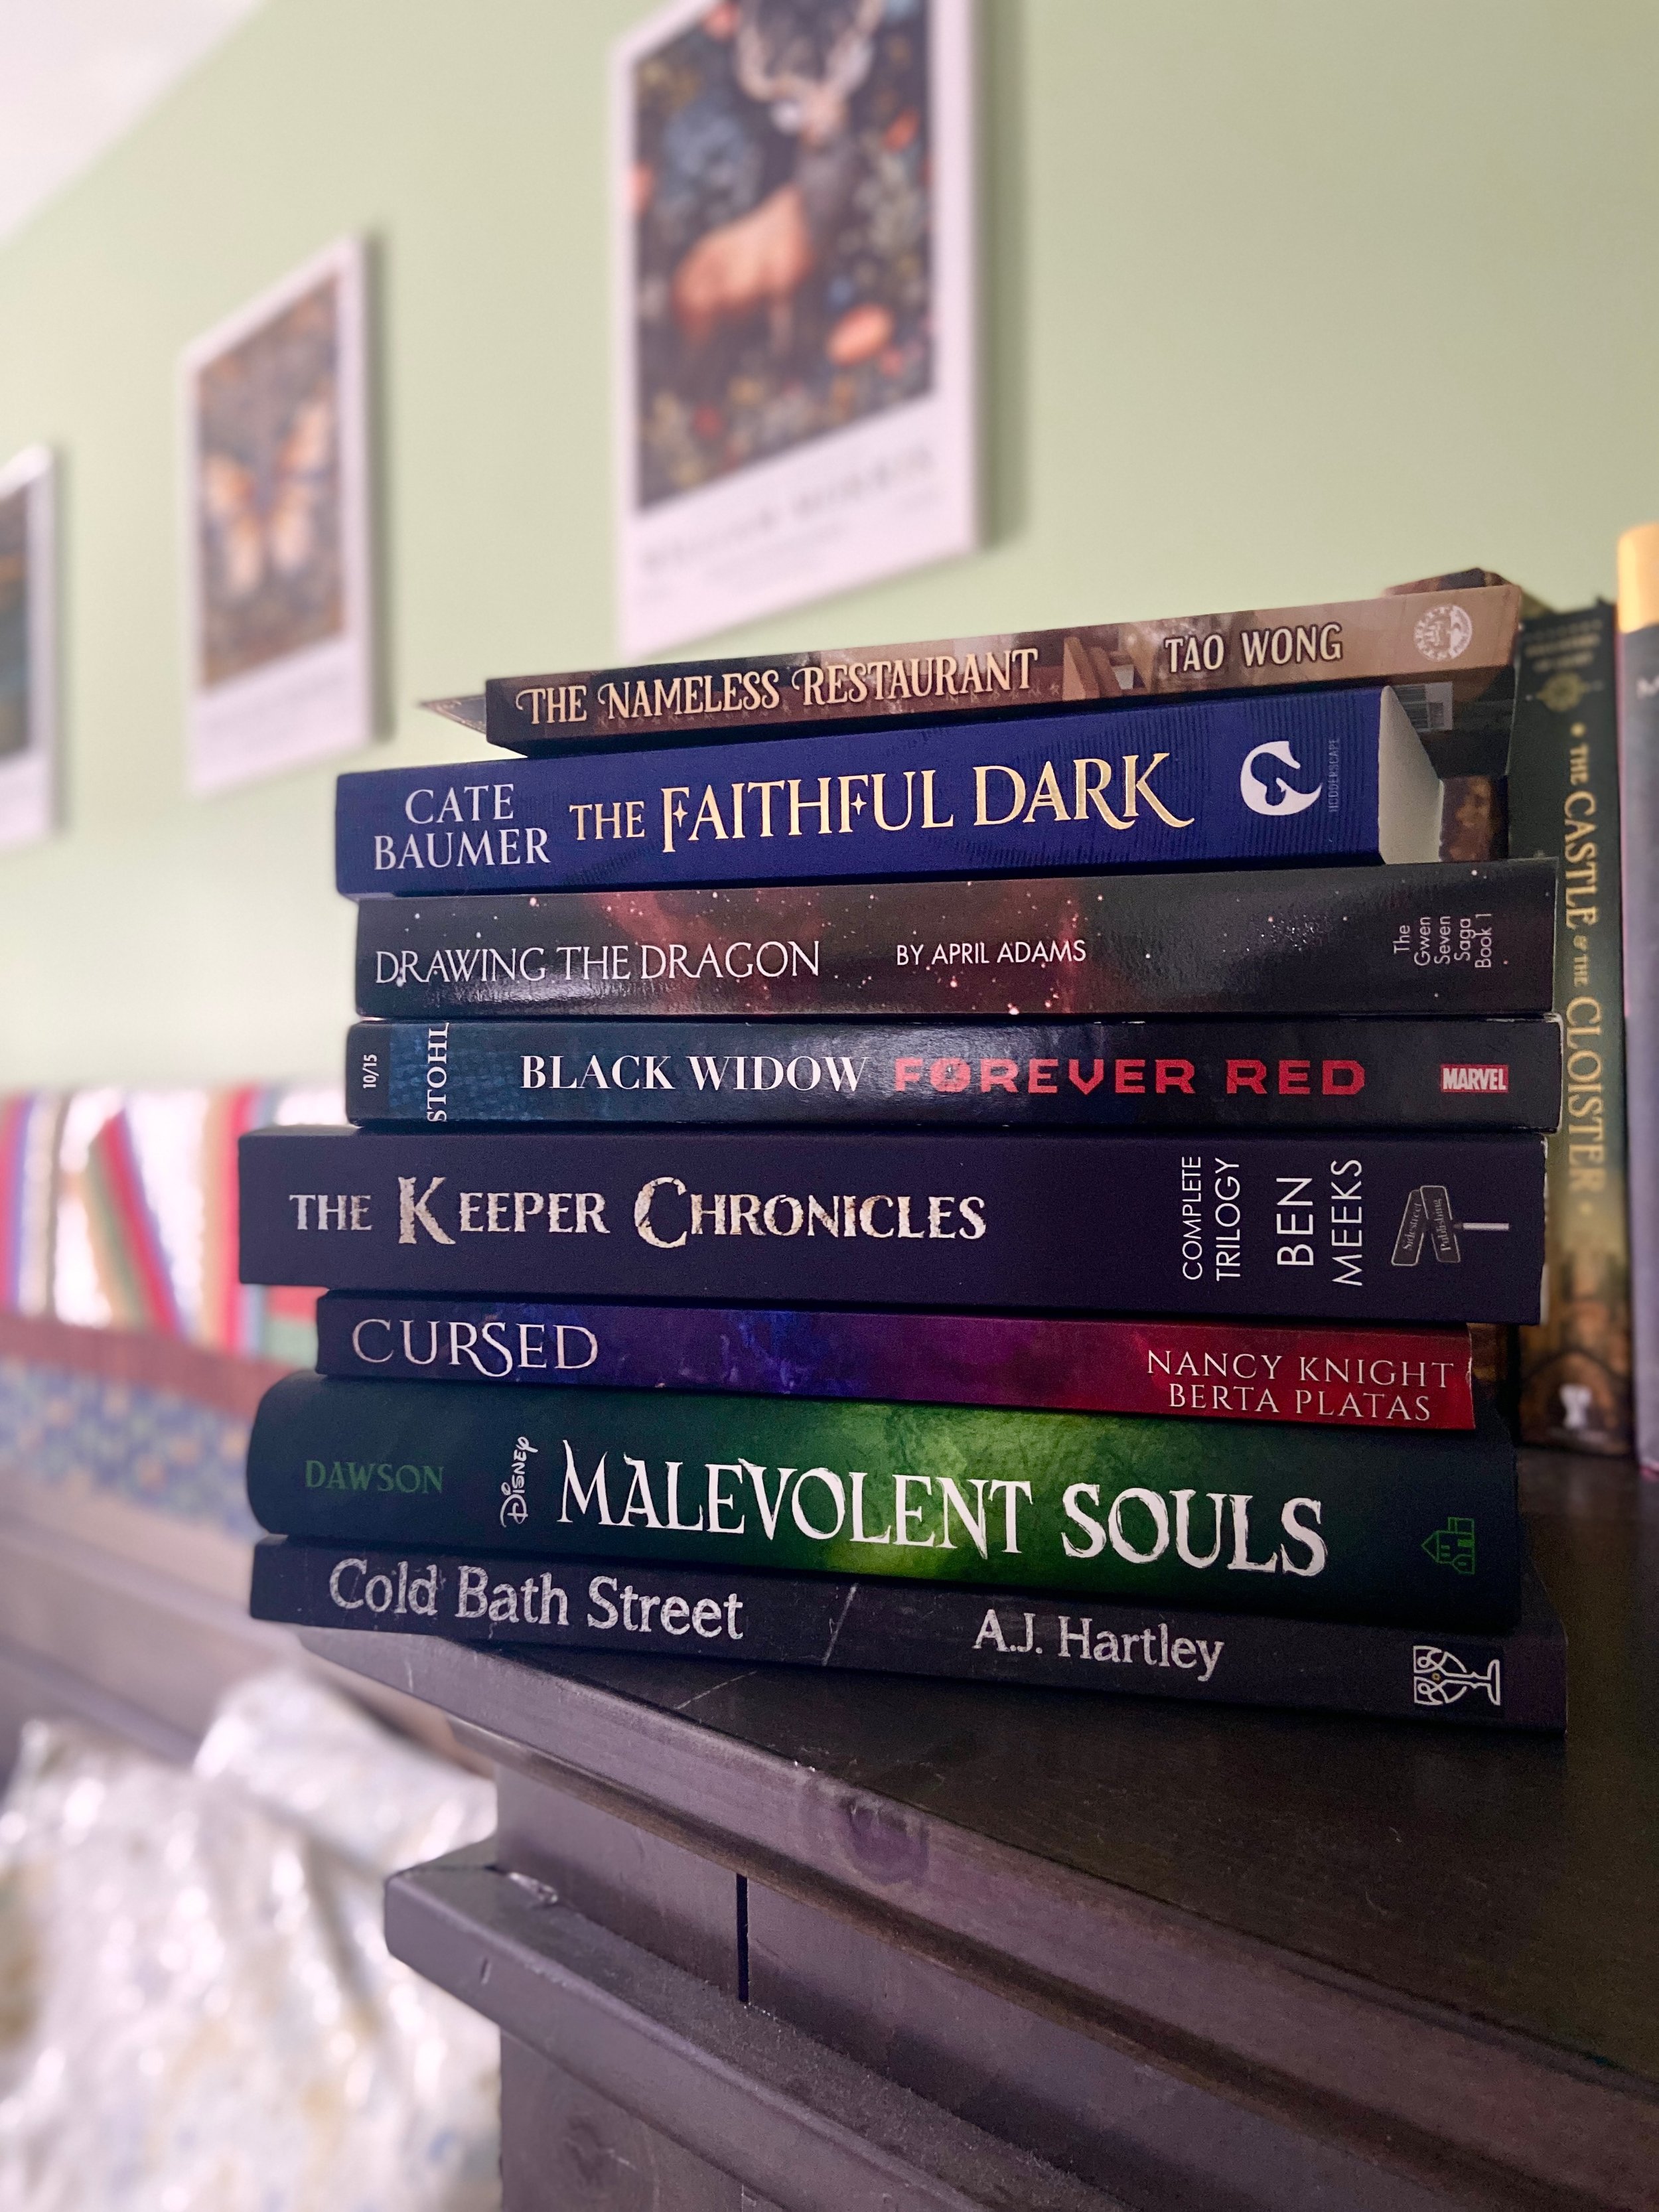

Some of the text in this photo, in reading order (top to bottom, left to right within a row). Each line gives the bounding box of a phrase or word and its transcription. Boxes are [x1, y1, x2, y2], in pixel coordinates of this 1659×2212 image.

[1165, 623, 1342, 674] TAO WONG
[516, 648, 1039, 725] THE NAMELESS RESTAURANT
[1569, 743, 1589, 786] THE
[405, 784, 514, 824] CATE
[569, 753, 1194, 853] THE FAITHFUL DARK
[374, 828, 551, 870] BAUMER
[1564, 791, 1597, 930] CASTLE
[376, 940, 820, 984] DRAWING THE DRAGON
[897, 940, 1087, 966] BY APRIL ADAMS
[1393, 924, 1411, 954] The
[1414, 917, 1431, 966] Gwen
[1434, 916, 1451, 964] Seven
[1454, 918, 1476, 961] Saga
[1475, 927, 1492, 968] Book
[1573, 955, 1589, 987] THE
[363, 1053, 378, 1089] 10/15
[427, 1022, 450, 1122] STOHL
[520, 1055, 1365, 1095] BLACK WIDOW FOREVER RED
[1443, 1067, 1507, 1090] MARVEL
[1566, 996, 1607, 1193] CLOISTER
[289, 1176, 987, 1248] THE KEEPER CHRONICLES
[1182, 1156, 1203, 1280] COMPLETE
[1215, 1157, 1241, 1282] TRILOGY
[1276, 1177, 1314, 1266] BEN
[1331, 1159, 1362, 1286] MEEKS
[1433, 1199, 1451, 1251] Publishing
[352, 1318, 599, 1378] CURSED
[1147, 1350, 1454, 1388] NANCY KNIGHT
[1169, 1383, 1431, 1422] BERTA PLATAS
[305, 1460, 444, 1495] DAWSON
[557, 1439, 1328, 1577] MALEVOLENT SOULS
[330, 1558, 745, 1640] Cold Bath Street
[972, 1609, 1224, 1682] A.J. Hartley
